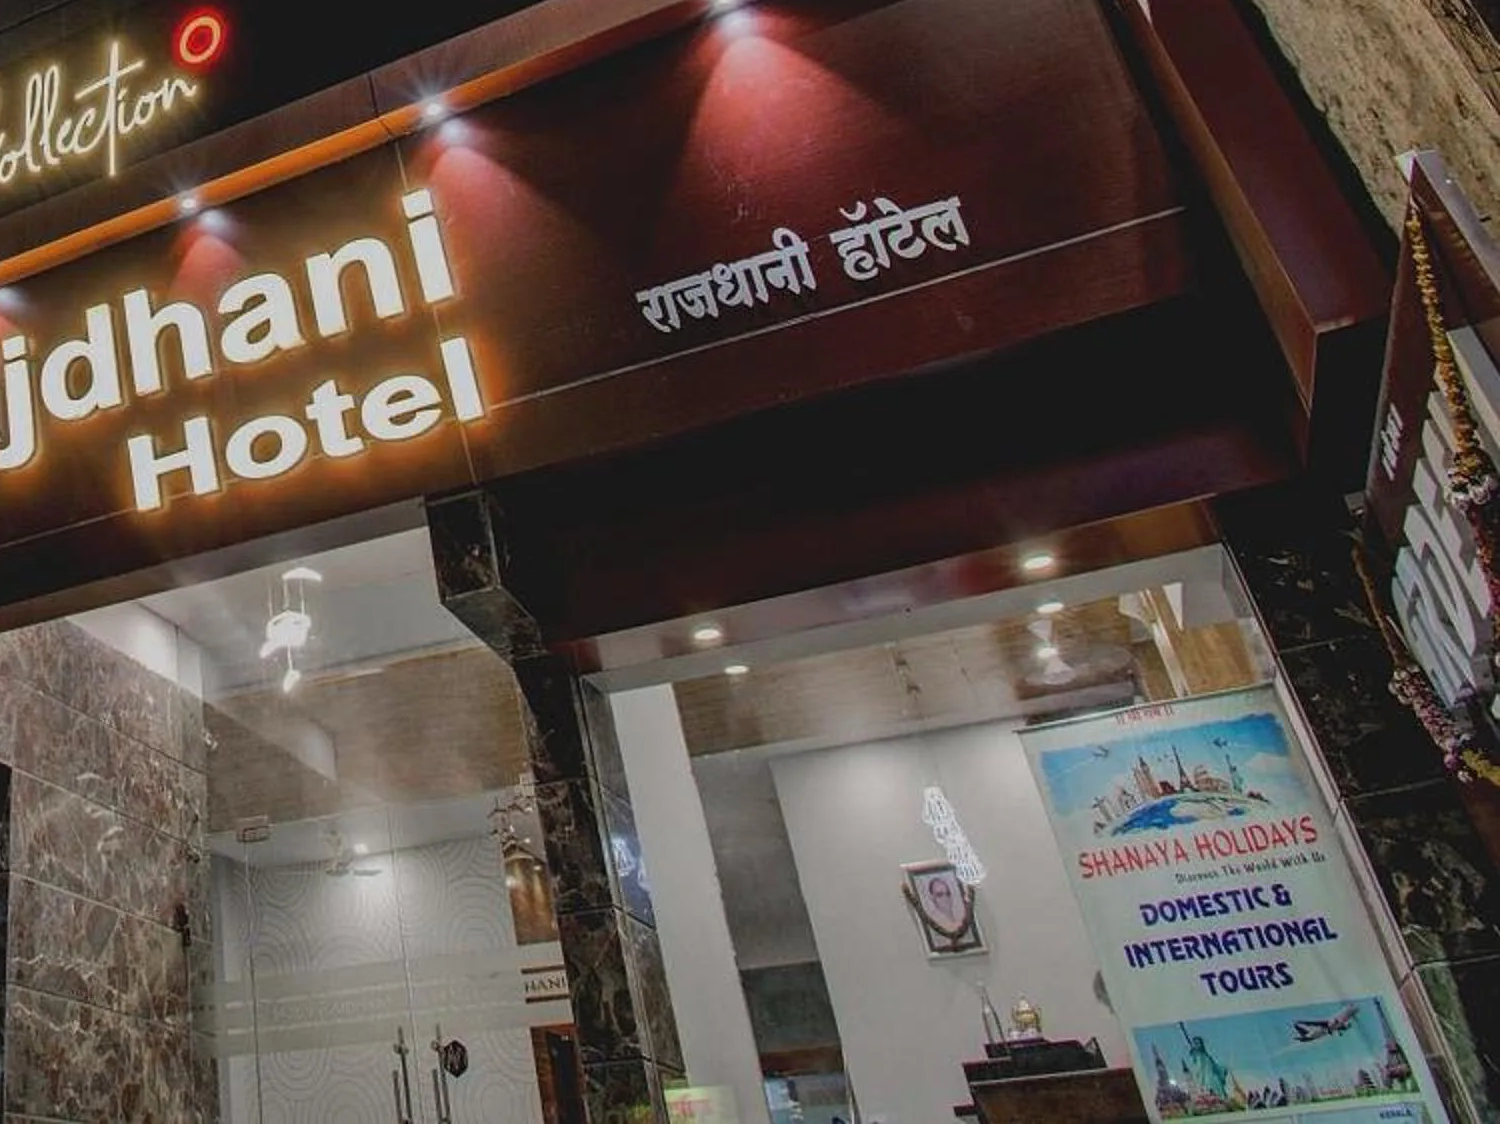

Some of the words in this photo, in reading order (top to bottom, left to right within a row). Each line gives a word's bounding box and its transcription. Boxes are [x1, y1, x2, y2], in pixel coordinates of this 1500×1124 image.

[636, 227, 817, 333] राजधानी
[829, 196, 971, 281] हॉटेल
[128, 337, 485, 512] Hotel
[1078, 838, 1190, 878] SHANAYA
[1194, 816, 1319, 858] HOLIDAYS
[1139, 885, 1270, 926] DOMESTIC
[1271, 883, 1293, 907] &
[1124, 917, 1338, 969] INTERNATIONAL
[1200, 962, 1294, 996] TOURS
